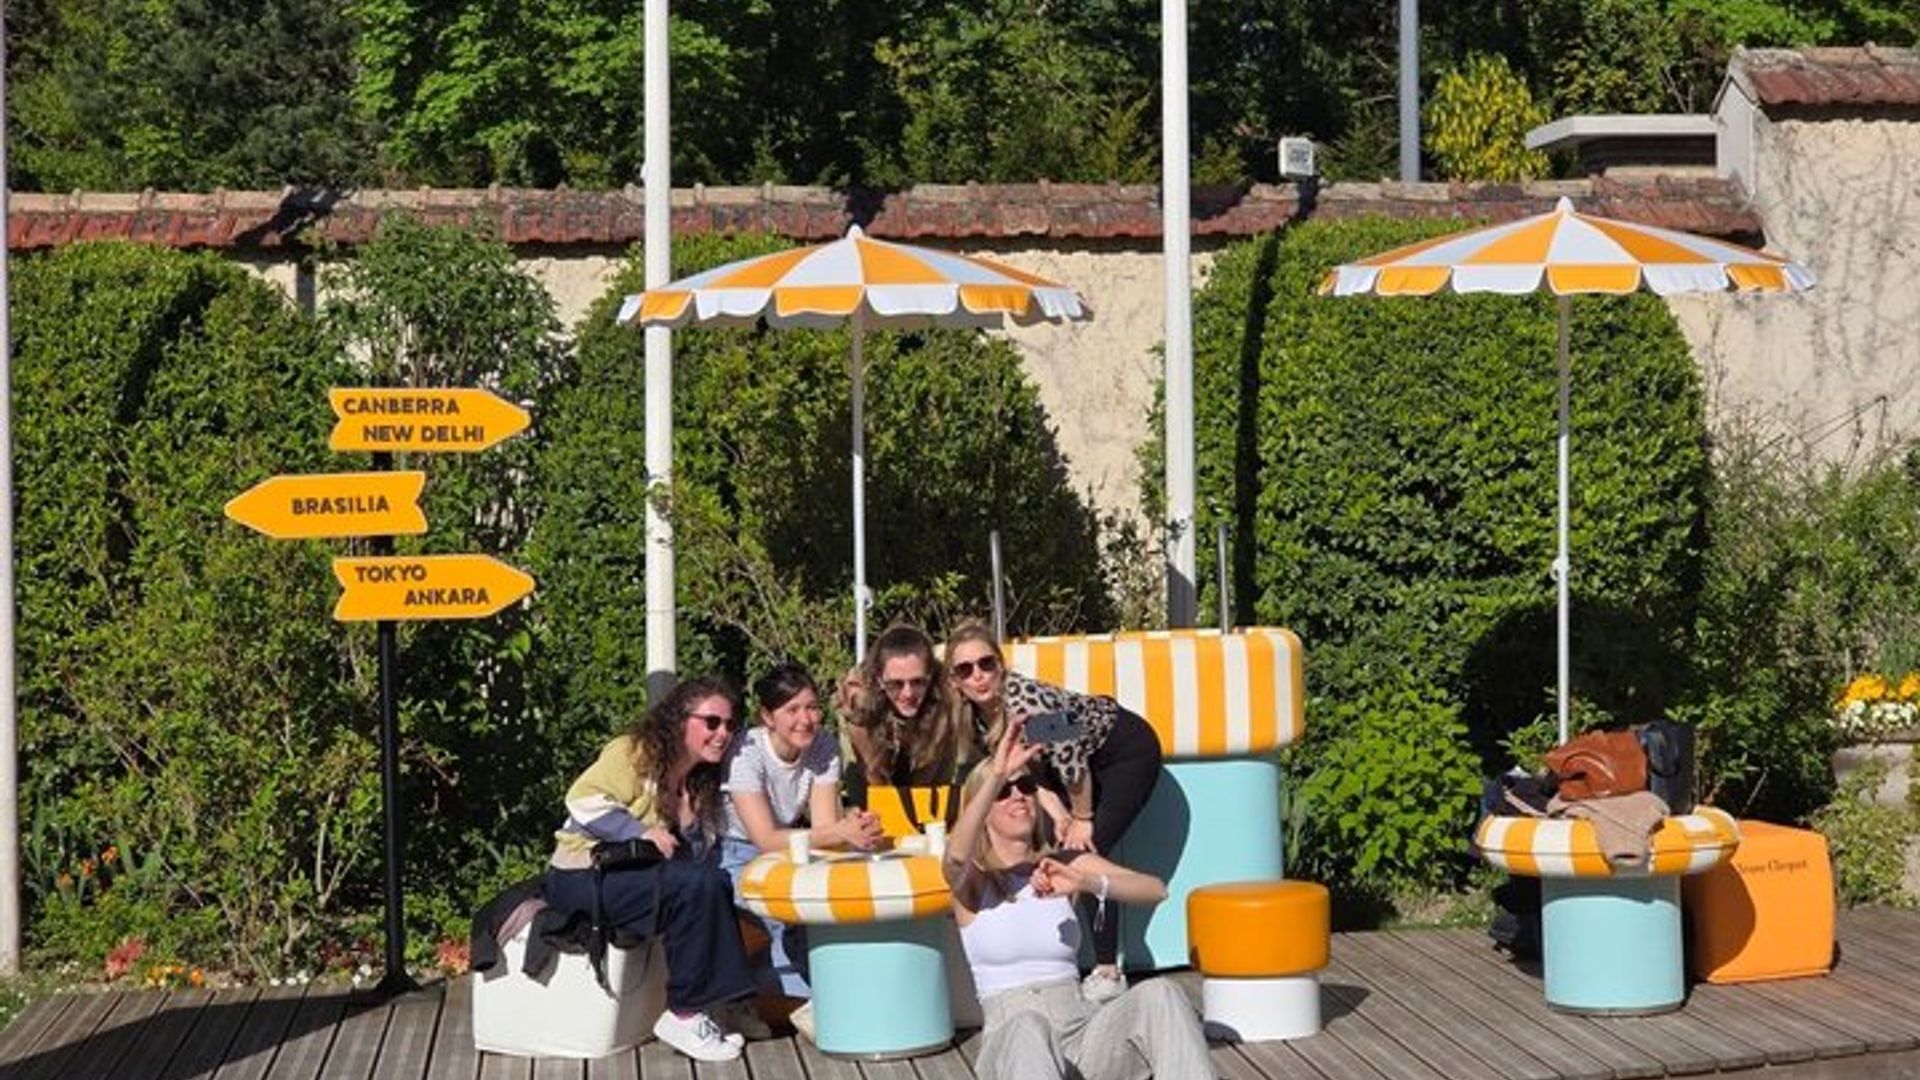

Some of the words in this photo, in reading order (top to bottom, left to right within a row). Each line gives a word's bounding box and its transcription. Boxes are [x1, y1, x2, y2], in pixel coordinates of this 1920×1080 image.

[344, 397, 460, 415] CANBERRA
[363, 425, 414, 443] NEW
[421, 425, 485, 443] DELHI
[292, 495, 389, 516] BRASILIA
[355, 564, 427, 583] TOKYO
[404, 587, 489, 606] ANKARA
